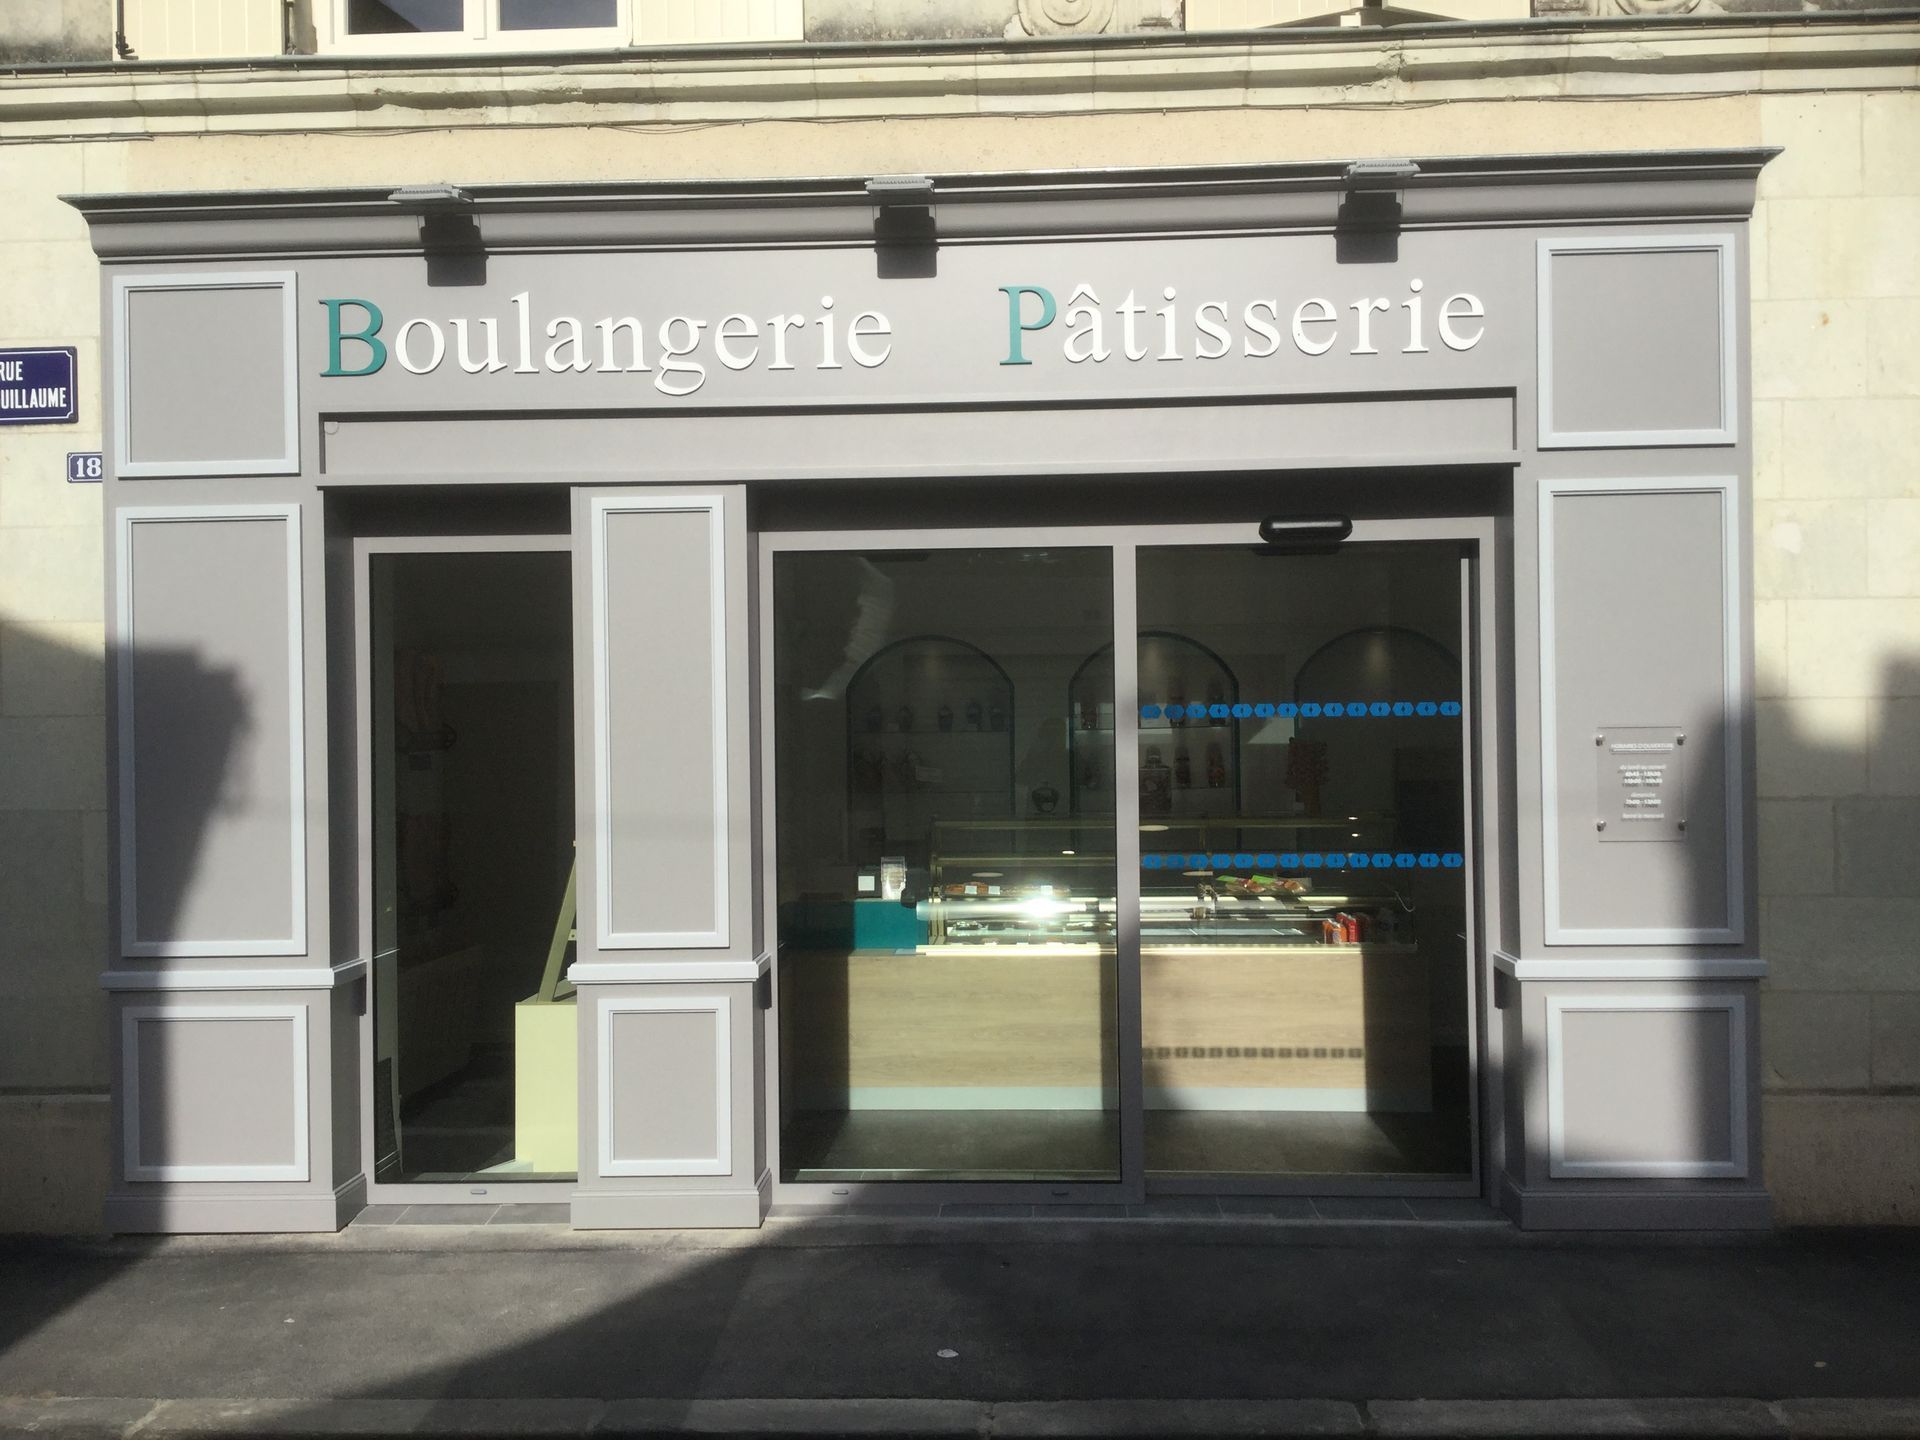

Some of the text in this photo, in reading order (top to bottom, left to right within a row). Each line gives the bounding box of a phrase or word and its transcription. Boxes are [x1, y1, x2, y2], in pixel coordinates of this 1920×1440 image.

[319, 278, 1486, 396] Boulangerie Pâtisserie
[76, 457, 102, 478] 18
